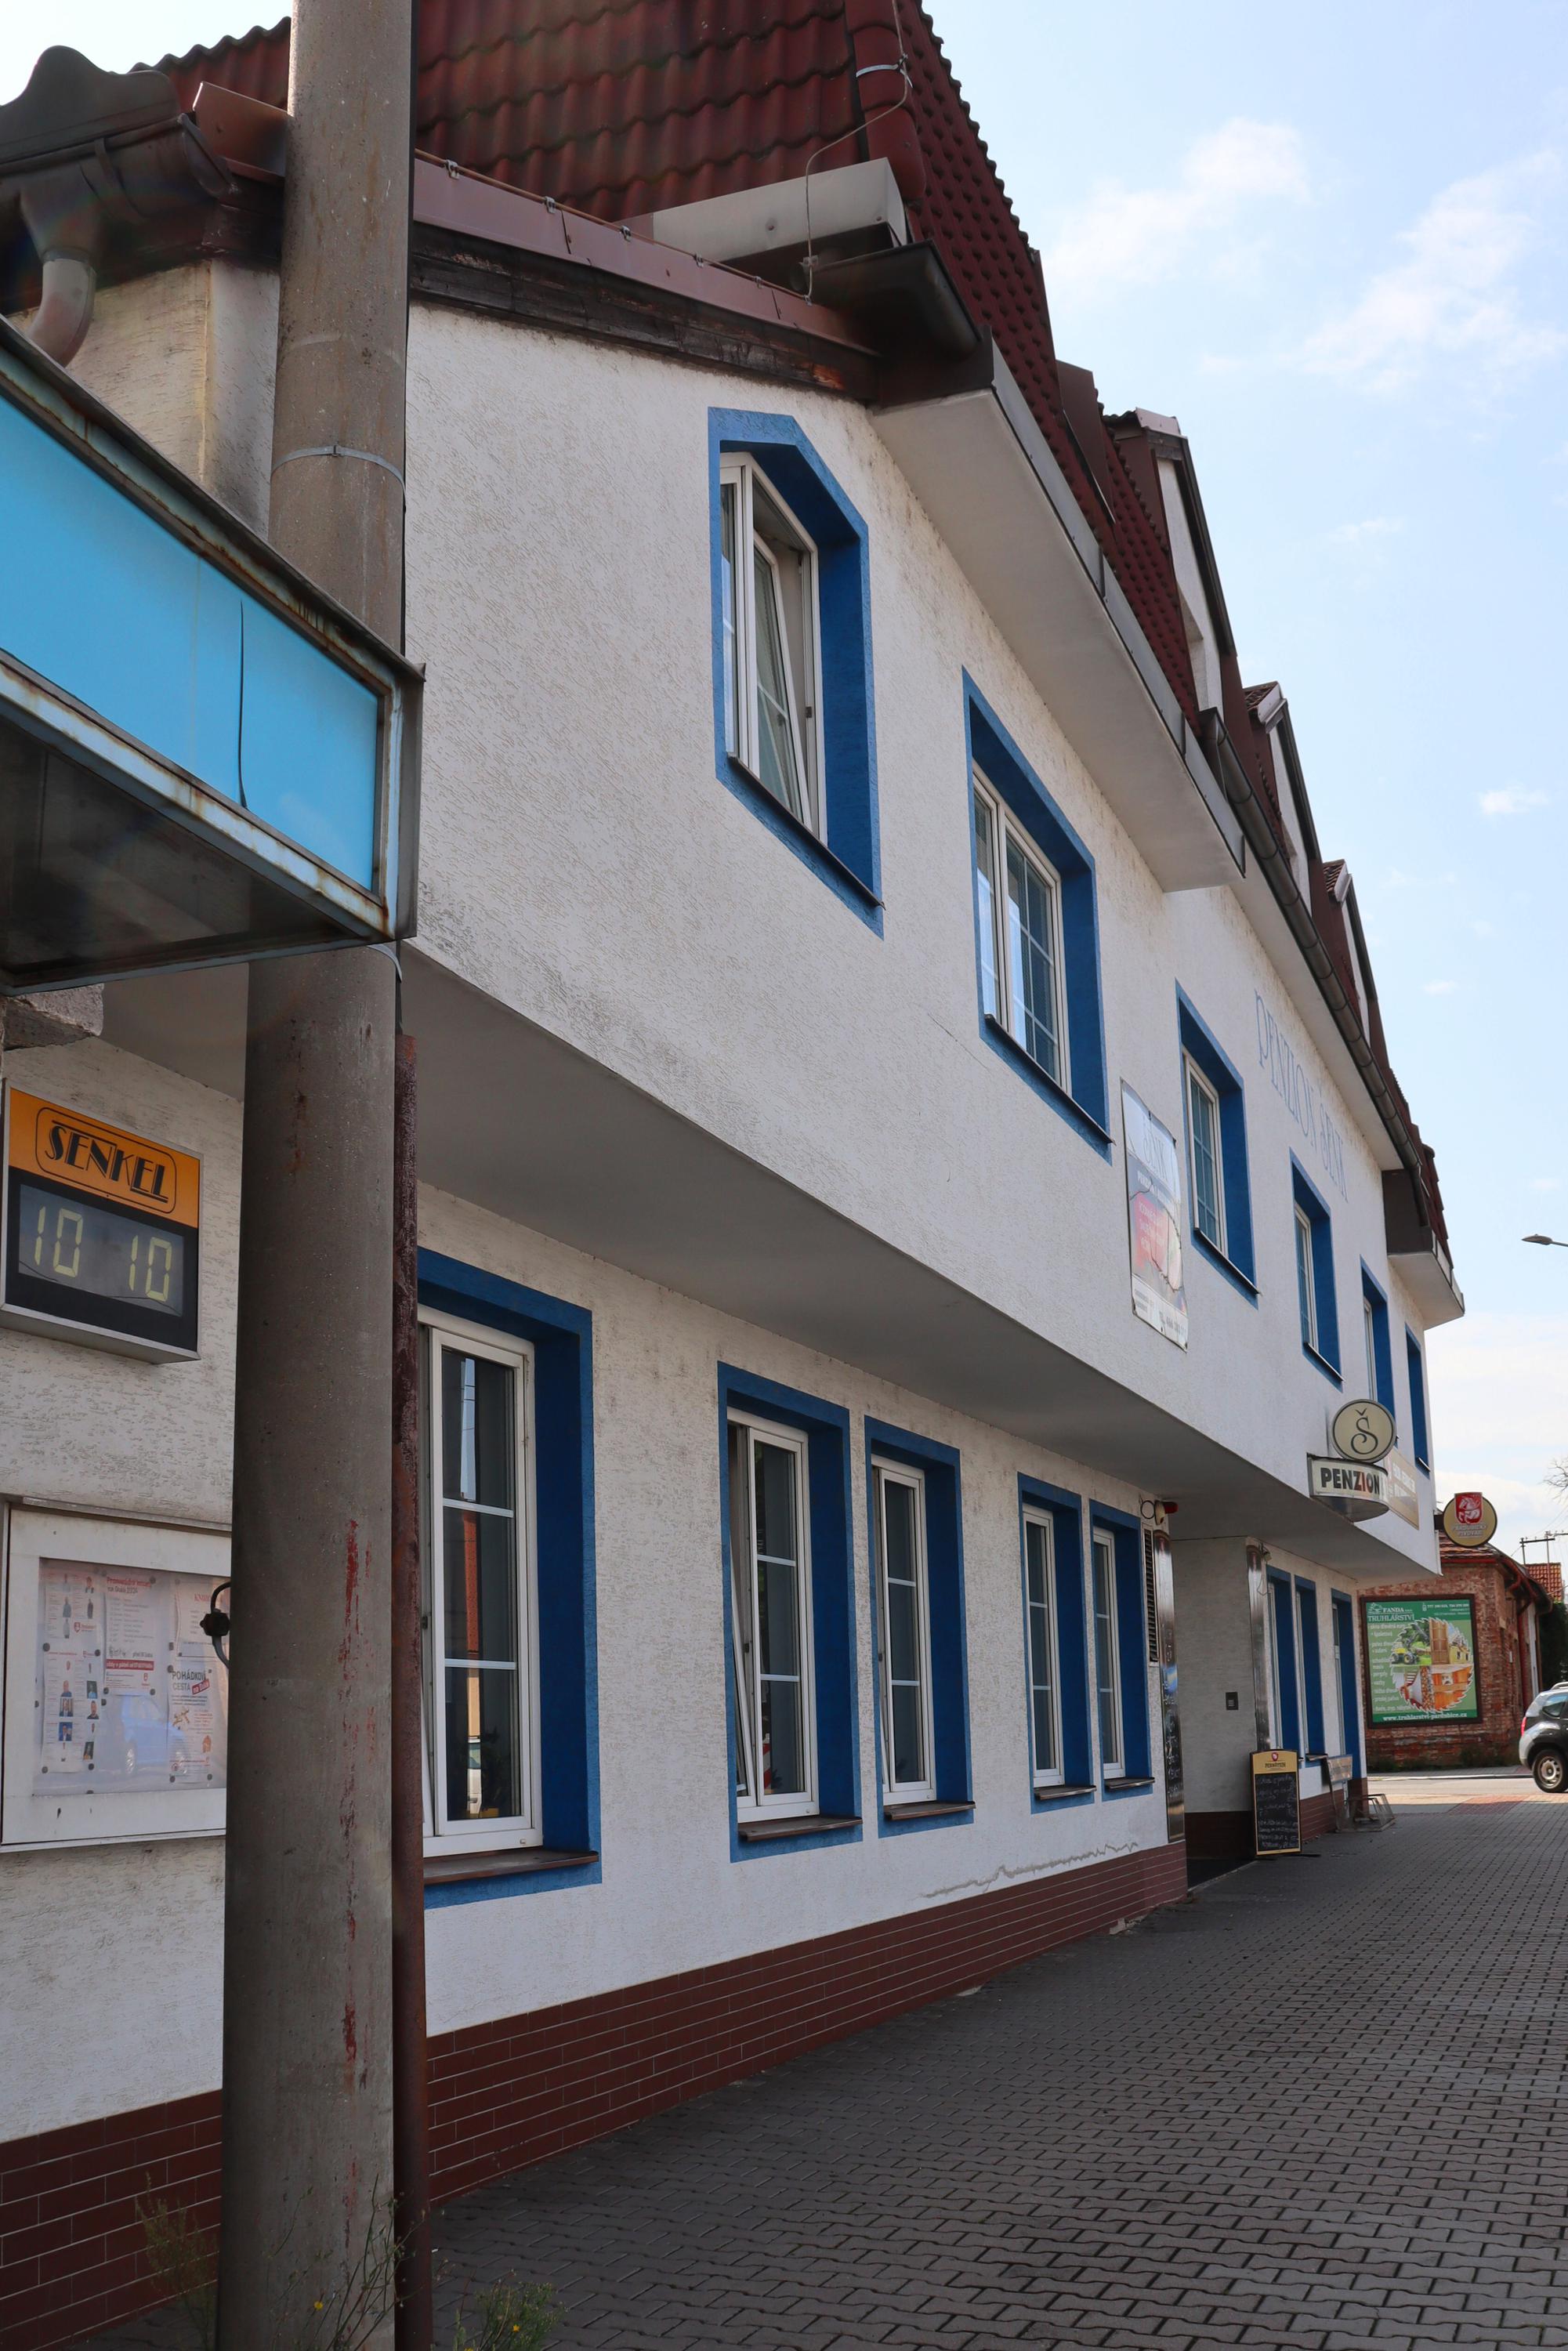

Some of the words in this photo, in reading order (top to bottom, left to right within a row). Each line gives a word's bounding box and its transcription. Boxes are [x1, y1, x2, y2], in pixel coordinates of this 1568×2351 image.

[1255, 990, 1317, 1154] PENZION
[34, 1205, 83, 1277] 10
[129, 1235, 172, 1302] 10
[1351, 1408, 1378, 1455] Š
[1320, 1468, 1380, 1494] PENZION
